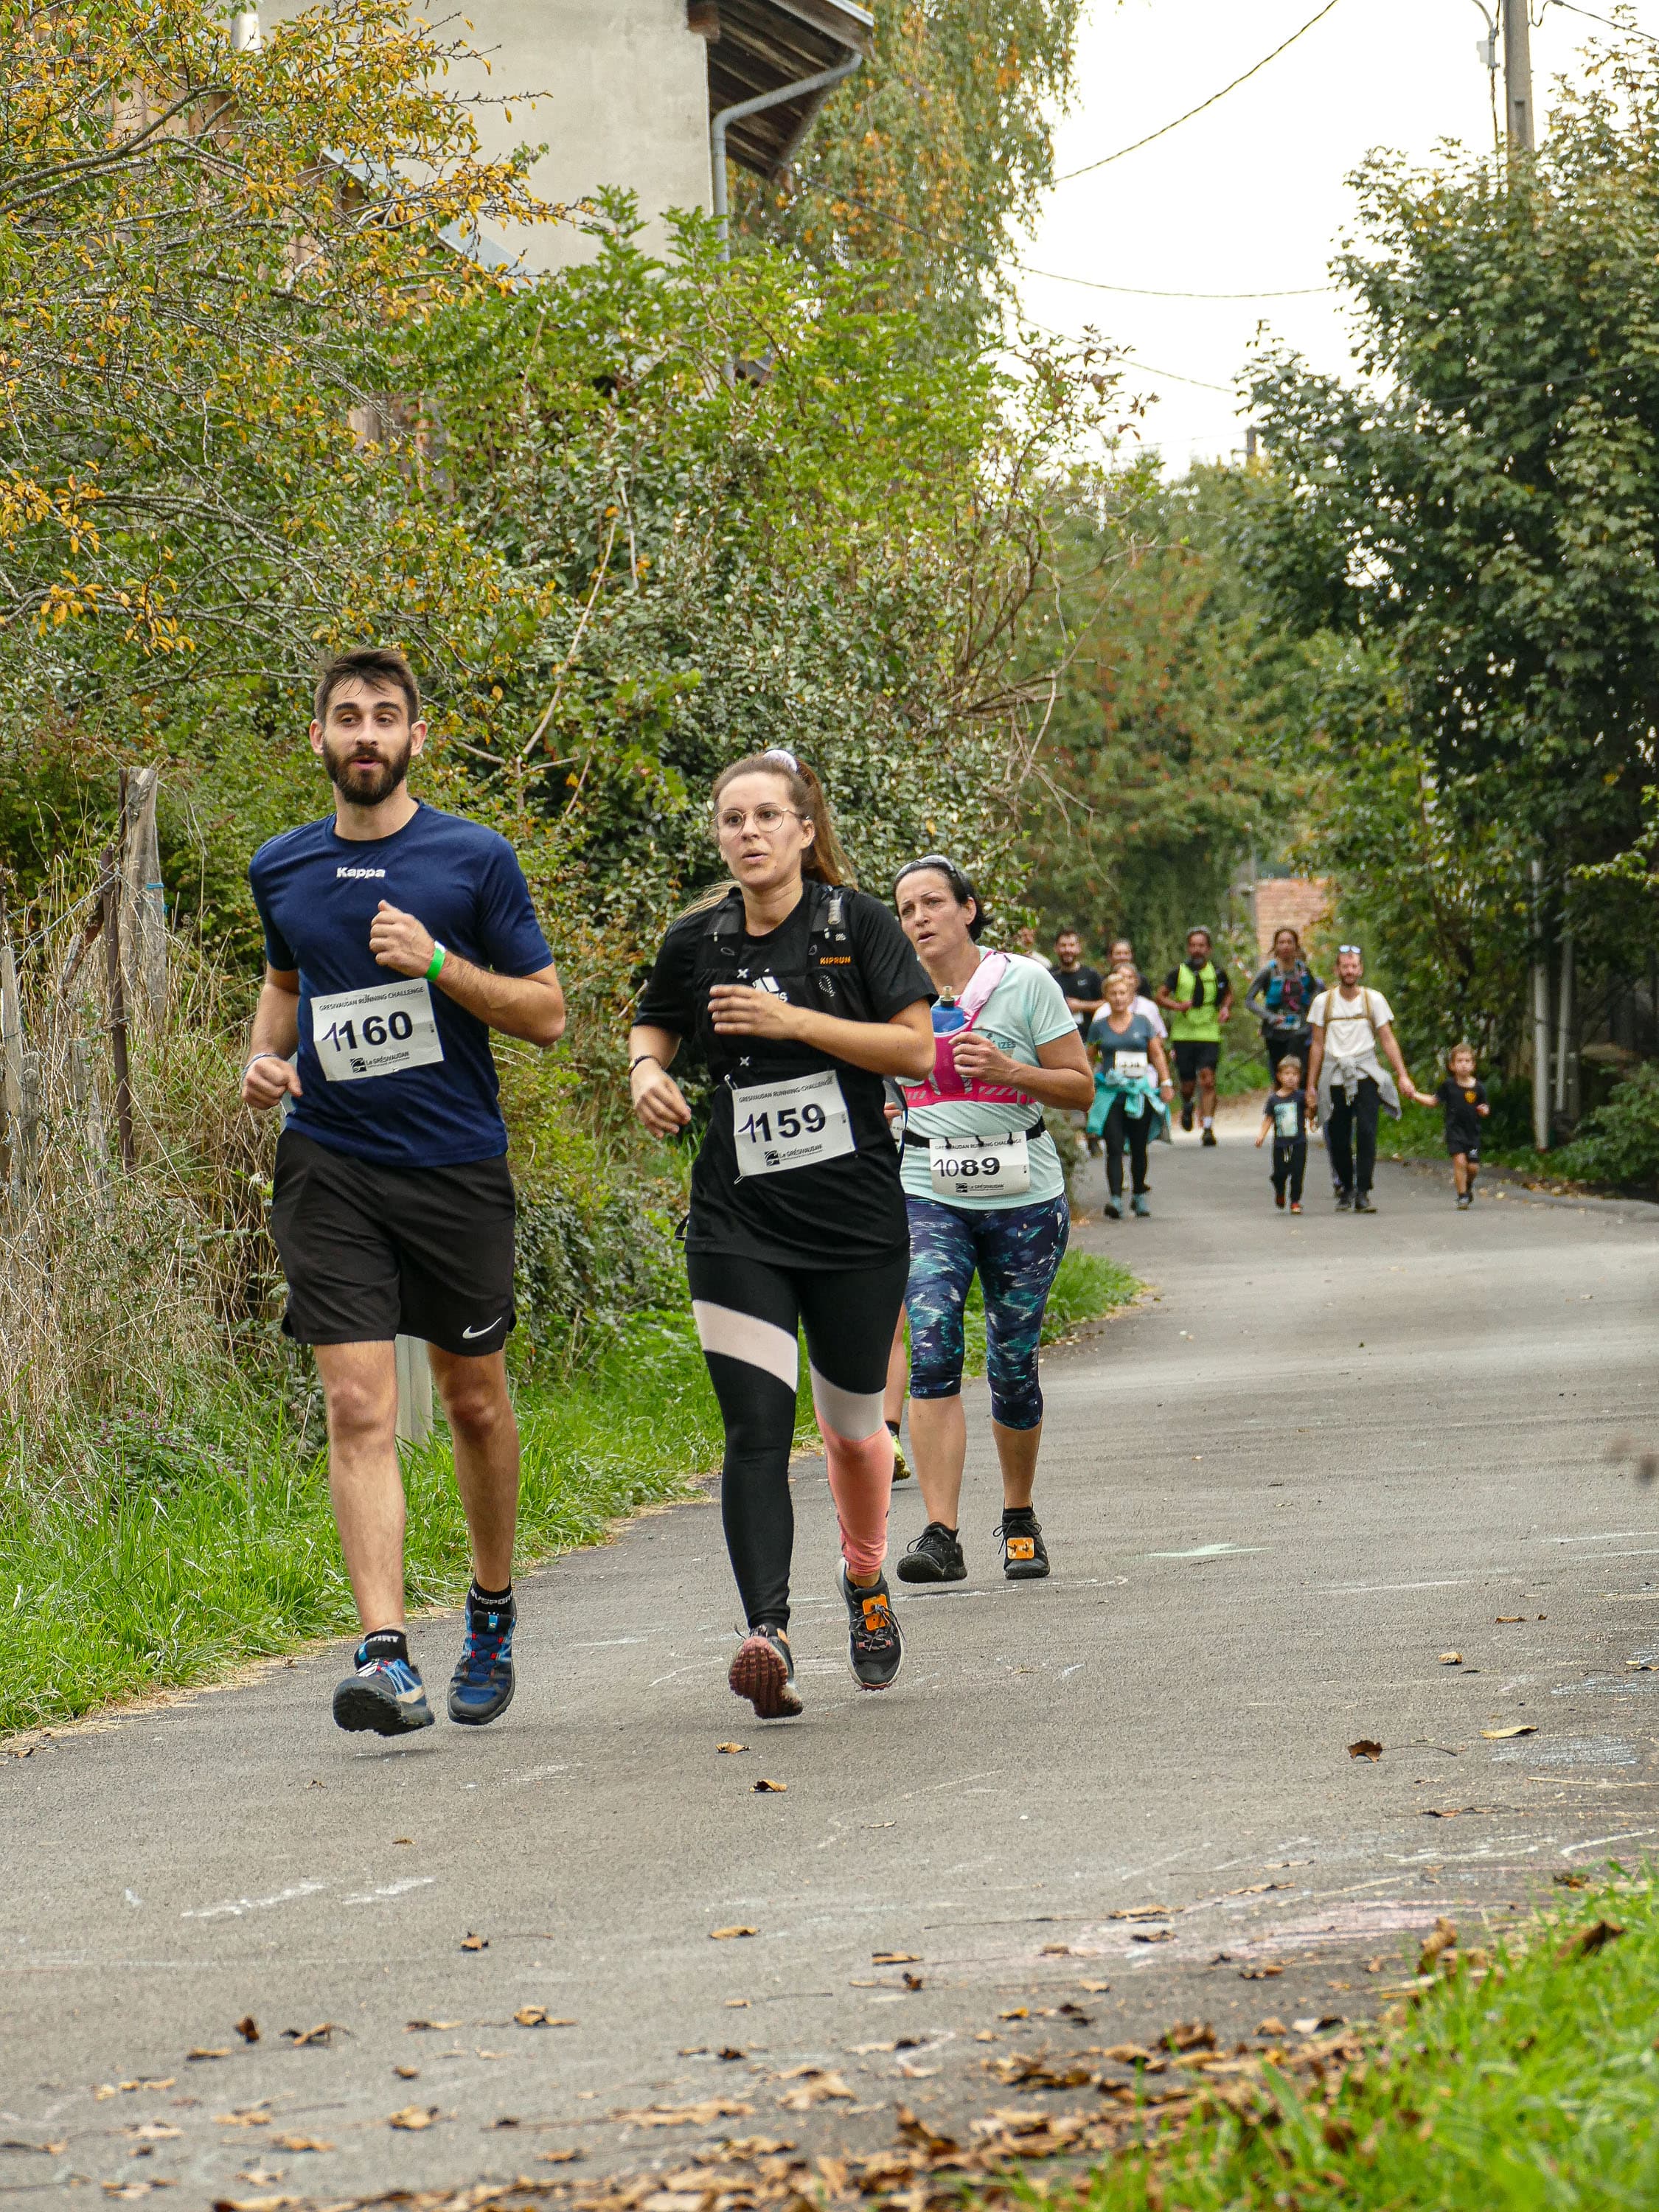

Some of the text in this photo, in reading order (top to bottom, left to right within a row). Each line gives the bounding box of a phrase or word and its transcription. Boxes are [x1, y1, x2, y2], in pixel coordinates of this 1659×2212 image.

[336, 867, 386, 879] Kappa
[819, 956, 851, 964] KIPRUN
[358, 993, 387, 1004] RUNNING
[388, 987, 425, 998] CHALLENGE
[321, 1011, 413, 1052] 1160
[773, 1088, 800, 1097] RUNNING
[738, 1103, 826, 1143] 1159
[933, 1157, 1000, 1177] 1089
